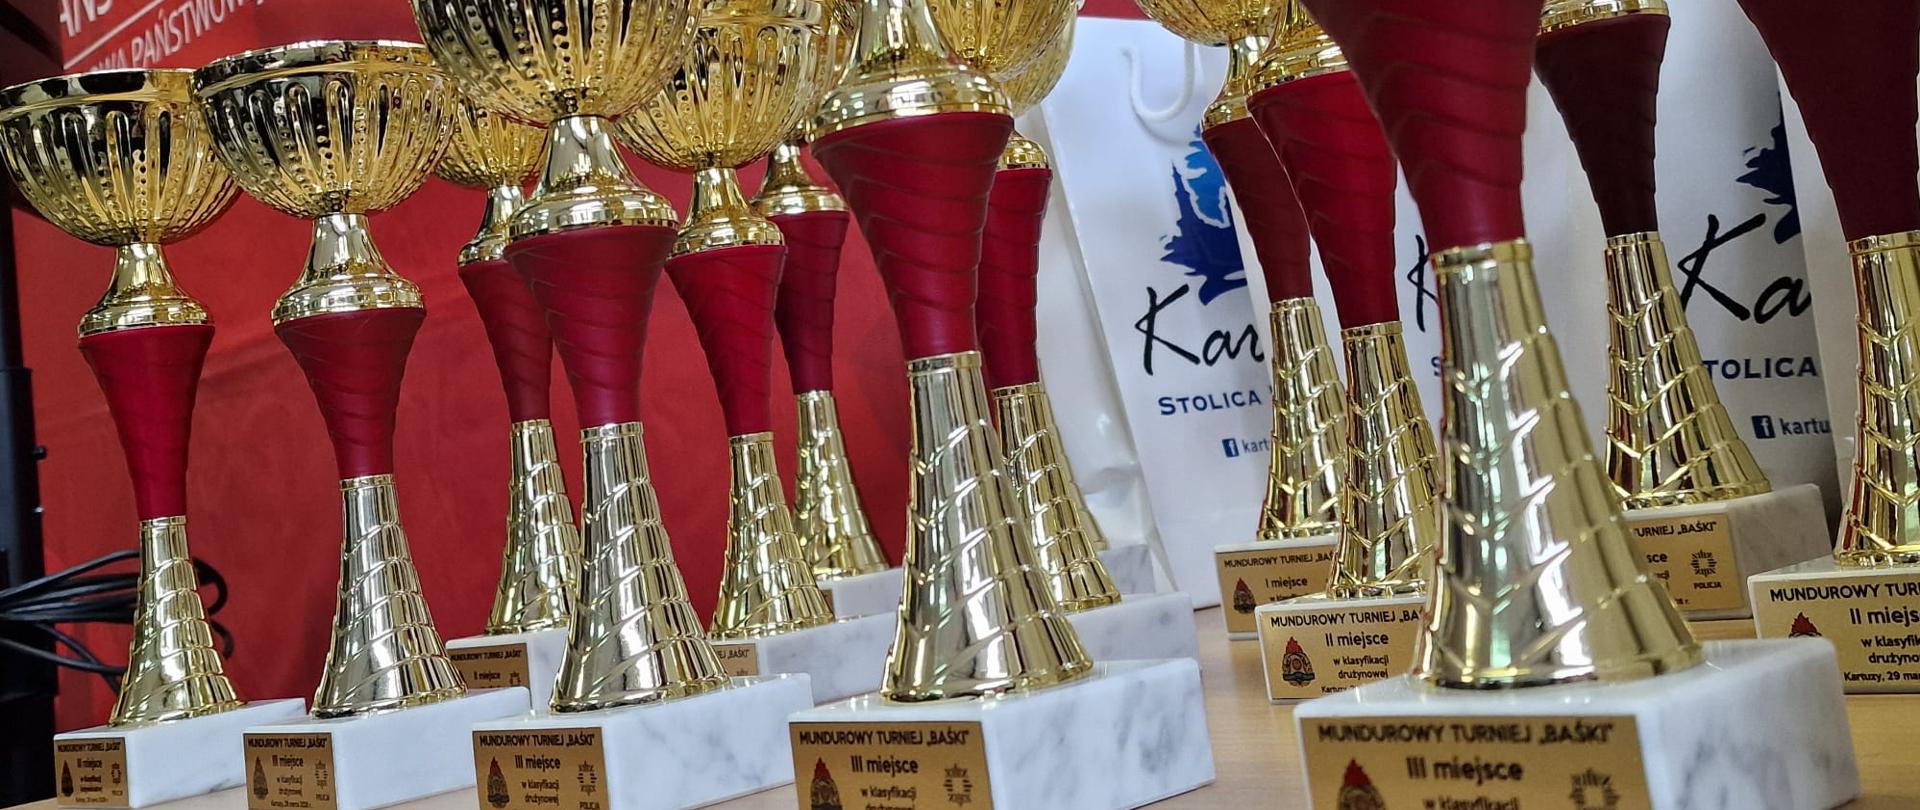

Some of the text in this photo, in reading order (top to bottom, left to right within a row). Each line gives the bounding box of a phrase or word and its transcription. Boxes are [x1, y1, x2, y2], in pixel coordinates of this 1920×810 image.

[1158, 390, 1262, 415] STOLICA
[1271, 576, 1308, 589] miejsce
[1770, 583, 1880, 602] MUNDUROWY
[1271, 611, 1346, 627] MUNDUROWY
[1349, 610, 1396, 624] TURNIEJ
[1850, 608, 1861, 624] II
[1325, 631, 1389, 649] II miejsce
[1861, 639, 1872, 647] w
[1333, 655, 1389, 667] w klasyfikacji
[480, 734, 531, 747] MUNDUROWY
[532, 734, 563, 746] TURNIEJ
[800, 730, 873, 745] MUNDUROWY
[876, 730, 923, 745] TURNIEJ
[1318, 724, 1445, 744] MUNDUROWY
[1451, 723, 1532, 743] TURNIEJ
[526, 755, 560, 772] miejsce
[851, 755, 918, 777] III miejsce
[1406, 755, 1523, 786] III miejsce
